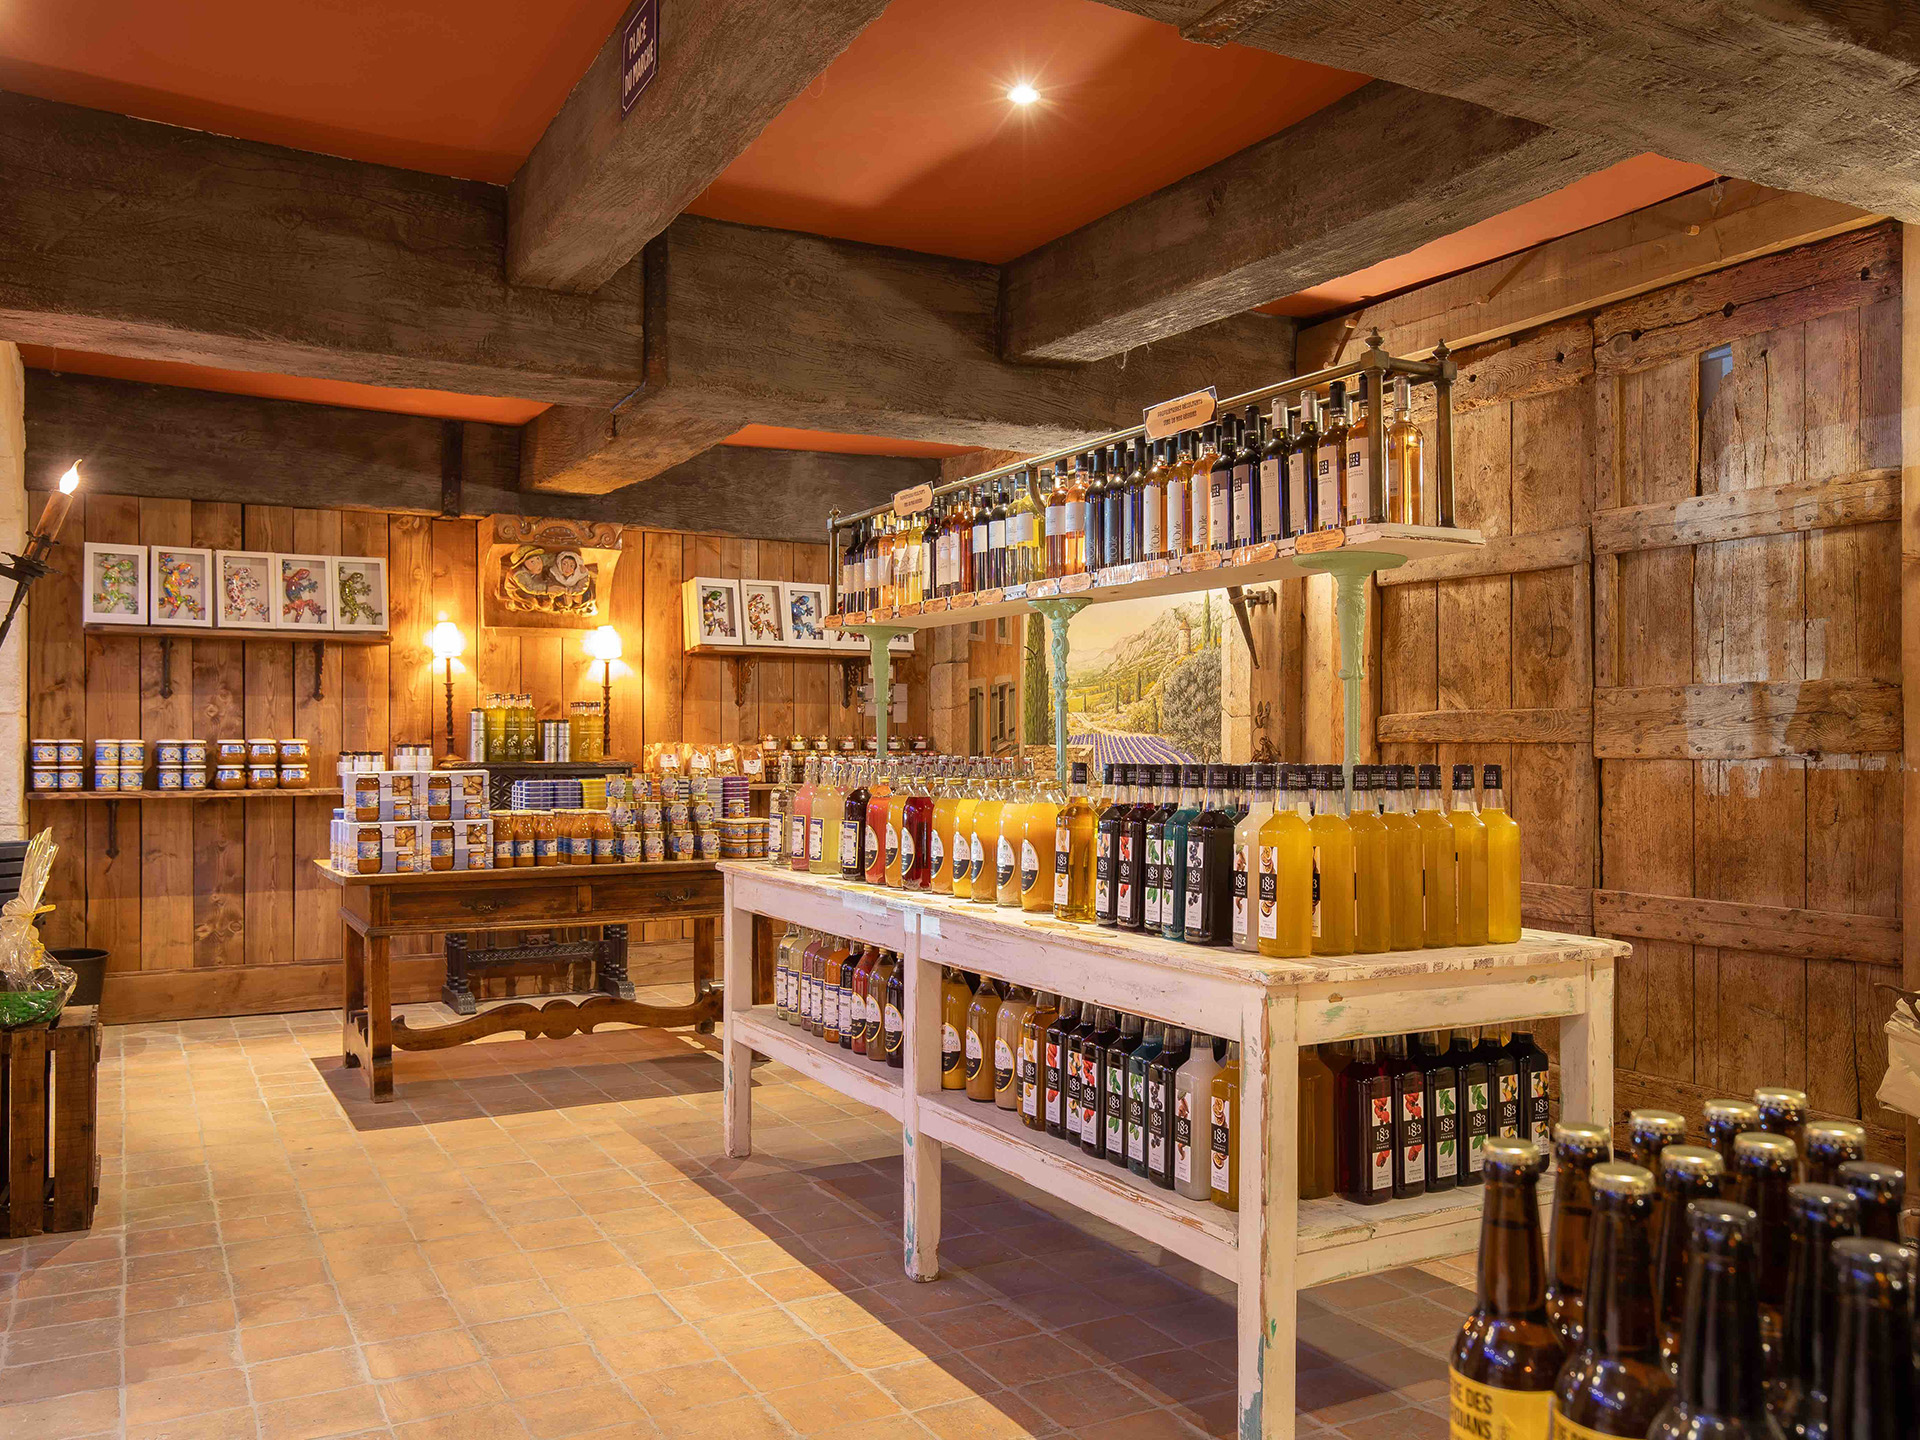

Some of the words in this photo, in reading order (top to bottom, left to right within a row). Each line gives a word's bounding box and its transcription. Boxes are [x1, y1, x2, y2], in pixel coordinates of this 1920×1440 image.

[629, 17, 647, 60] PLACE
[1058, 854, 1066, 867] 1883
[1098, 859, 1107, 872] 1883
[1121, 863, 1129, 876] 1883
[1148, 866, 1158, 880] 1883
[1164, 867, 1172, 880] 1883
[1189, 870, 1200, 883] 1883
[1236, 874, 1246, 888] 1883
[1262, 876, 1274, 891] 1883
[1026, 1063, 1034, 1077] 1883
[1048, 1069, 1058, 1082] 1883
[1070, 1078, 1080, 1092] 1883
[1084, 1088, 1094, 1101] 1883
[1109, 1095, 1120, 1109] 1883
[1535, 1099, 1548, 1113] 1883
[1131, 1102, 1141, 1117] 1883
[1504, 1103, 1516, 1117] 1883
[1151, 1111, 1162, 1126] 1883
[1441, 1118, 1454, 1132] 1883
[1473, 1112, 1486, 1127] 1883
[1177, 1120, 1189, 1135] 1883
[1376, 1127, 1389, 1142] 1883
[1408, 1122, 1422, 1137] 1883
[1213, 1128, 1226, 1143] 1883
[1466, 1389, 1492, 1414] DES
